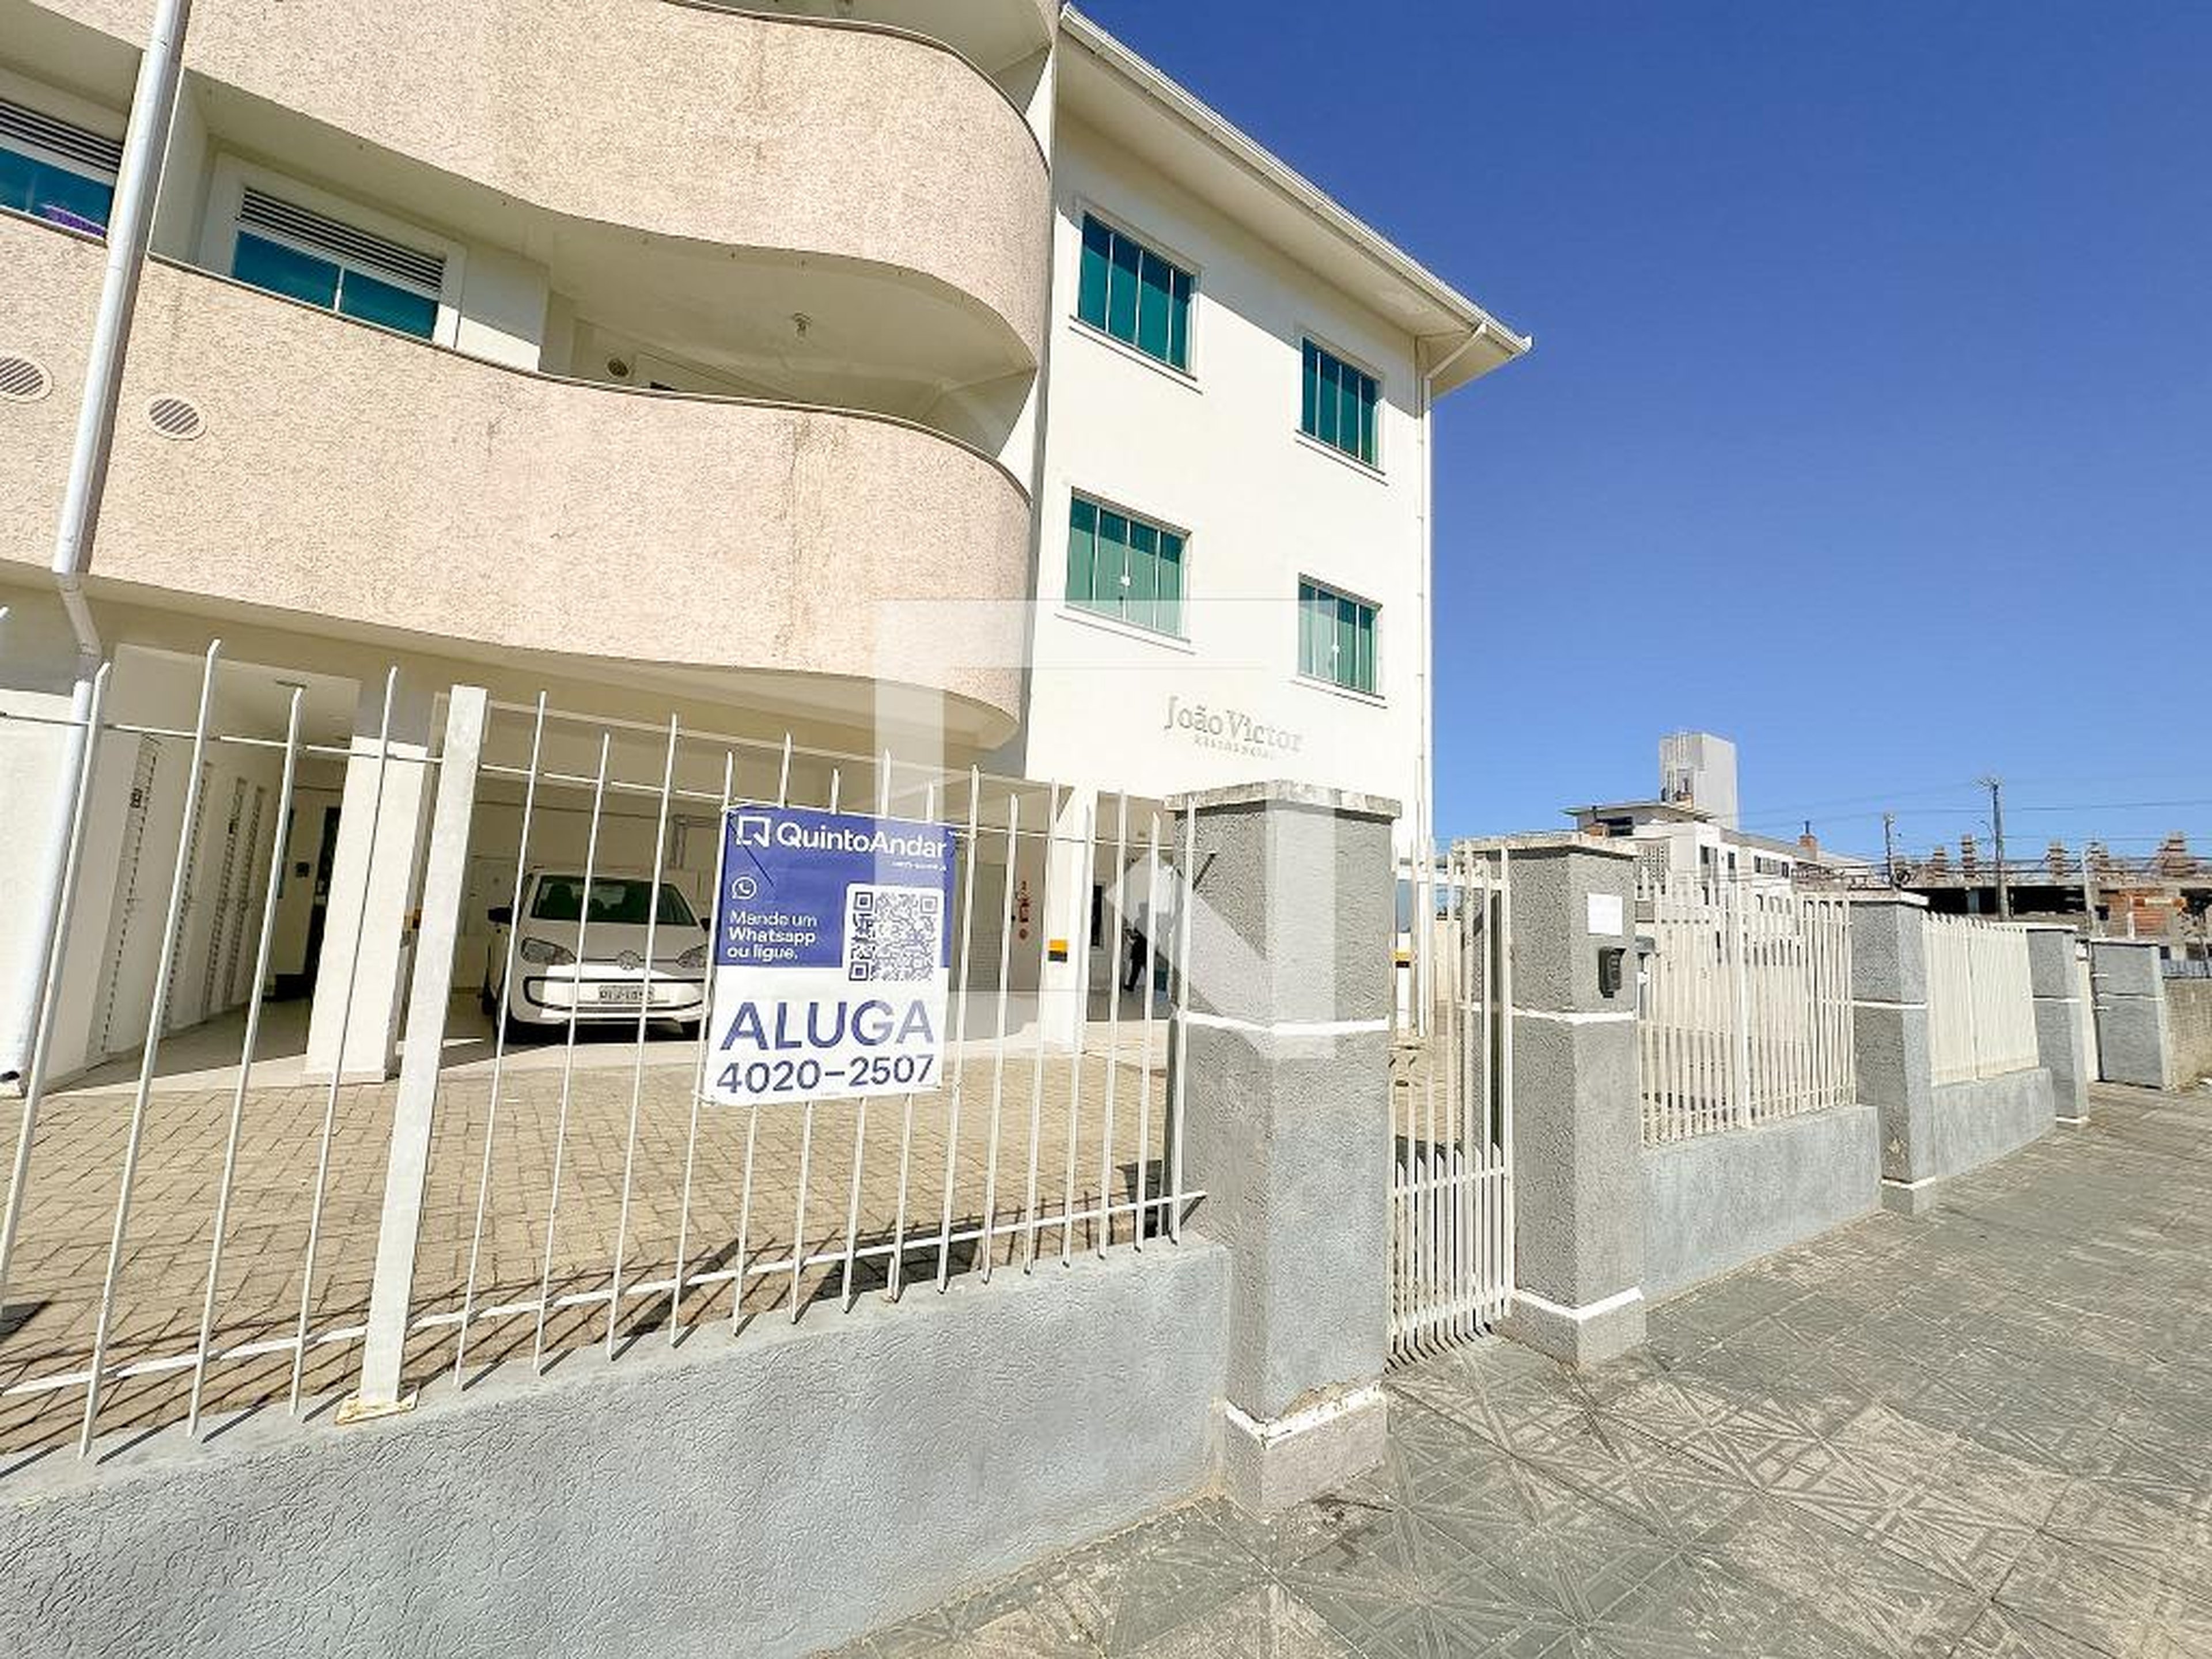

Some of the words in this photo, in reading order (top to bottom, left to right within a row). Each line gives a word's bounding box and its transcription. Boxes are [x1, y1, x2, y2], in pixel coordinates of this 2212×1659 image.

[1164, 695, 1224, 735] João
[777, 821, 946, 858] QuintoAndar
[729, 926, 816, 946] Whatsapp
[792, 915, 818, 927] um
[727, 946, 749, 958] ou
[753, 944, 798, 962] ligue.
[720, 999, 935, 1051] ALUGA
[716, 1054, 935, 1094] 4020-2507
